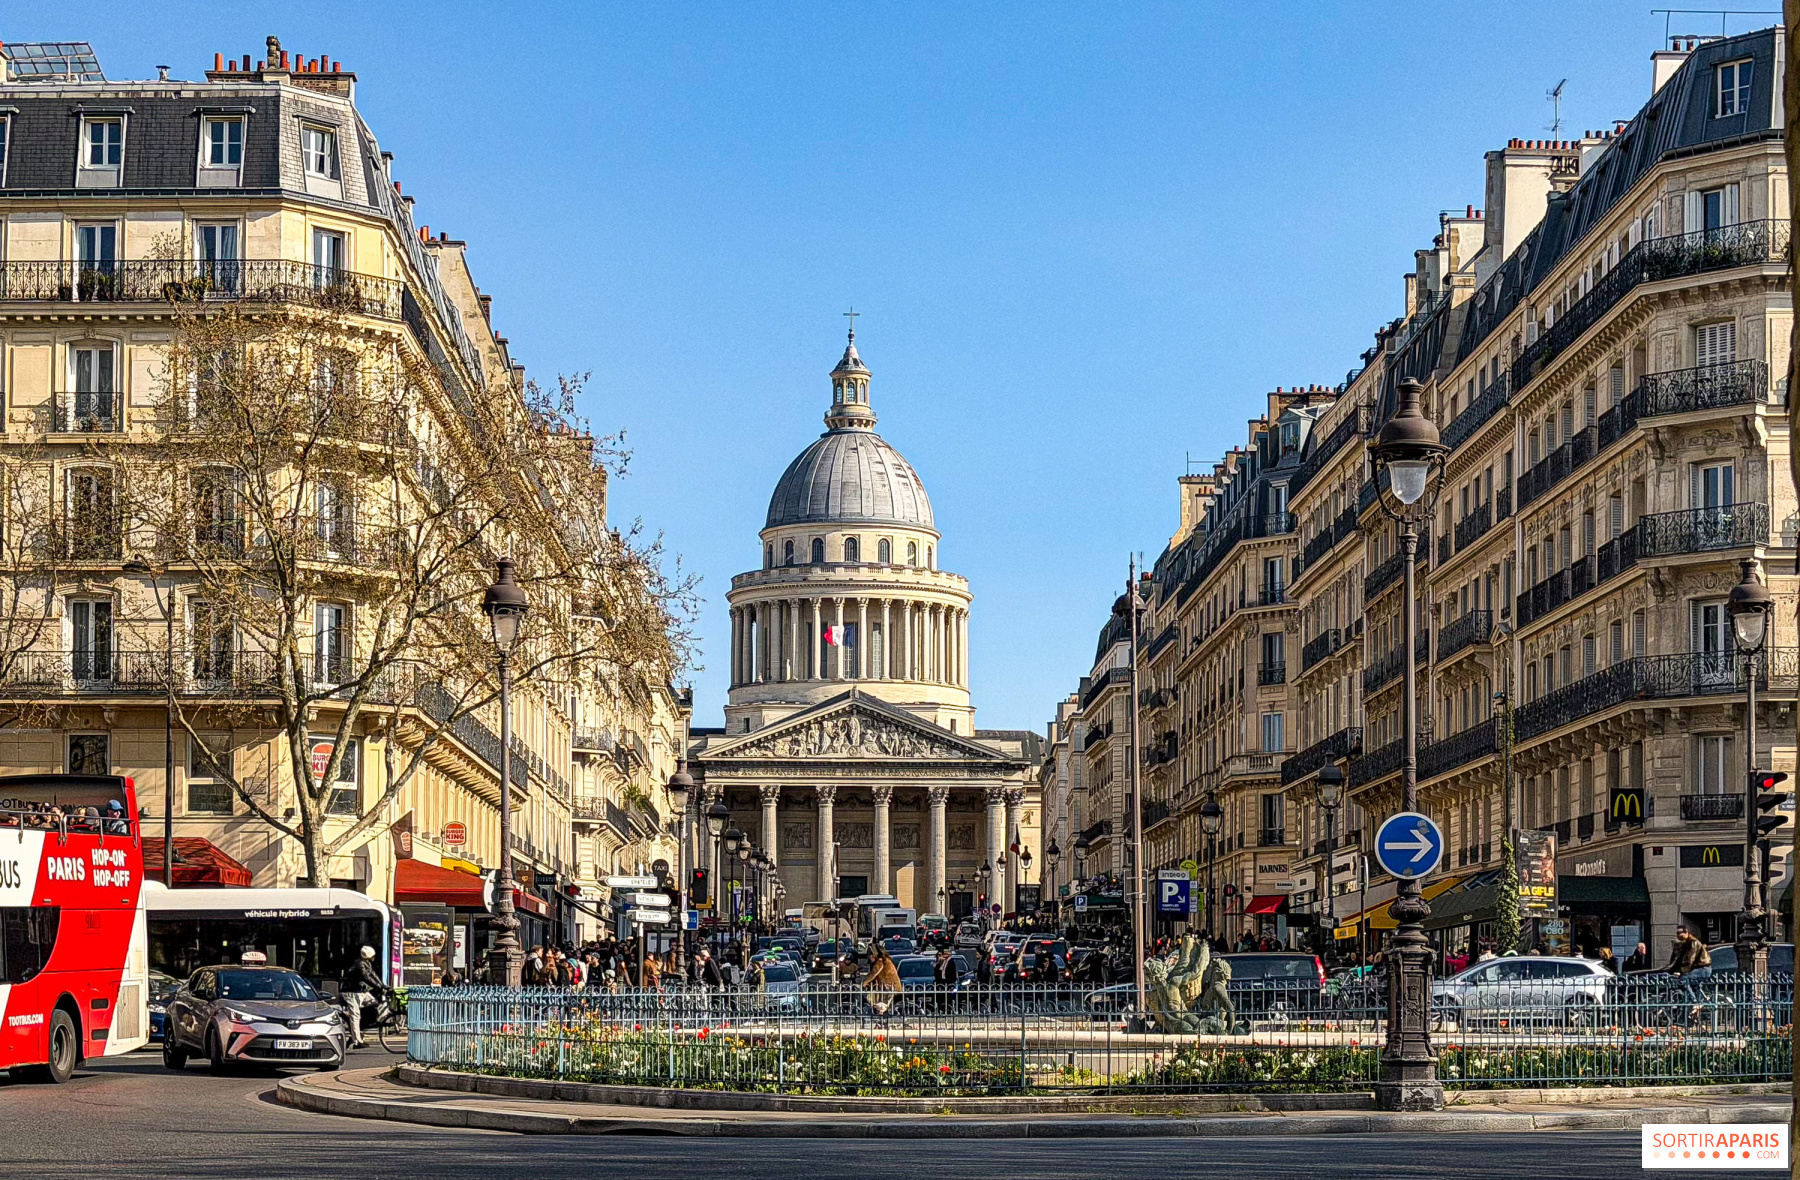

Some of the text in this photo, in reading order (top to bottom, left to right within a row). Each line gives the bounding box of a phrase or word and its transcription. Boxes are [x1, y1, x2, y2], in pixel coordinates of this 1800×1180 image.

[91, 848, 126, 867] HOP-ON
[47, 857, 86, 881] PARIS
[1259, 864, 1287, 873] BARNES
[1575, 859, 1606, 877] McDonald's
[93, 869, 130, 887] HOP-OFF
[1162, 882, 1179, 903] P
[1518, 885, 1555, 897] LA GIFLE
[1078, 897, 1084, 905] P
[244, 909, 278, 918] véhicule
[278, 909, 310, 918] hybride
[8, 1013, 44, 1027] TOOTBUS.COM
